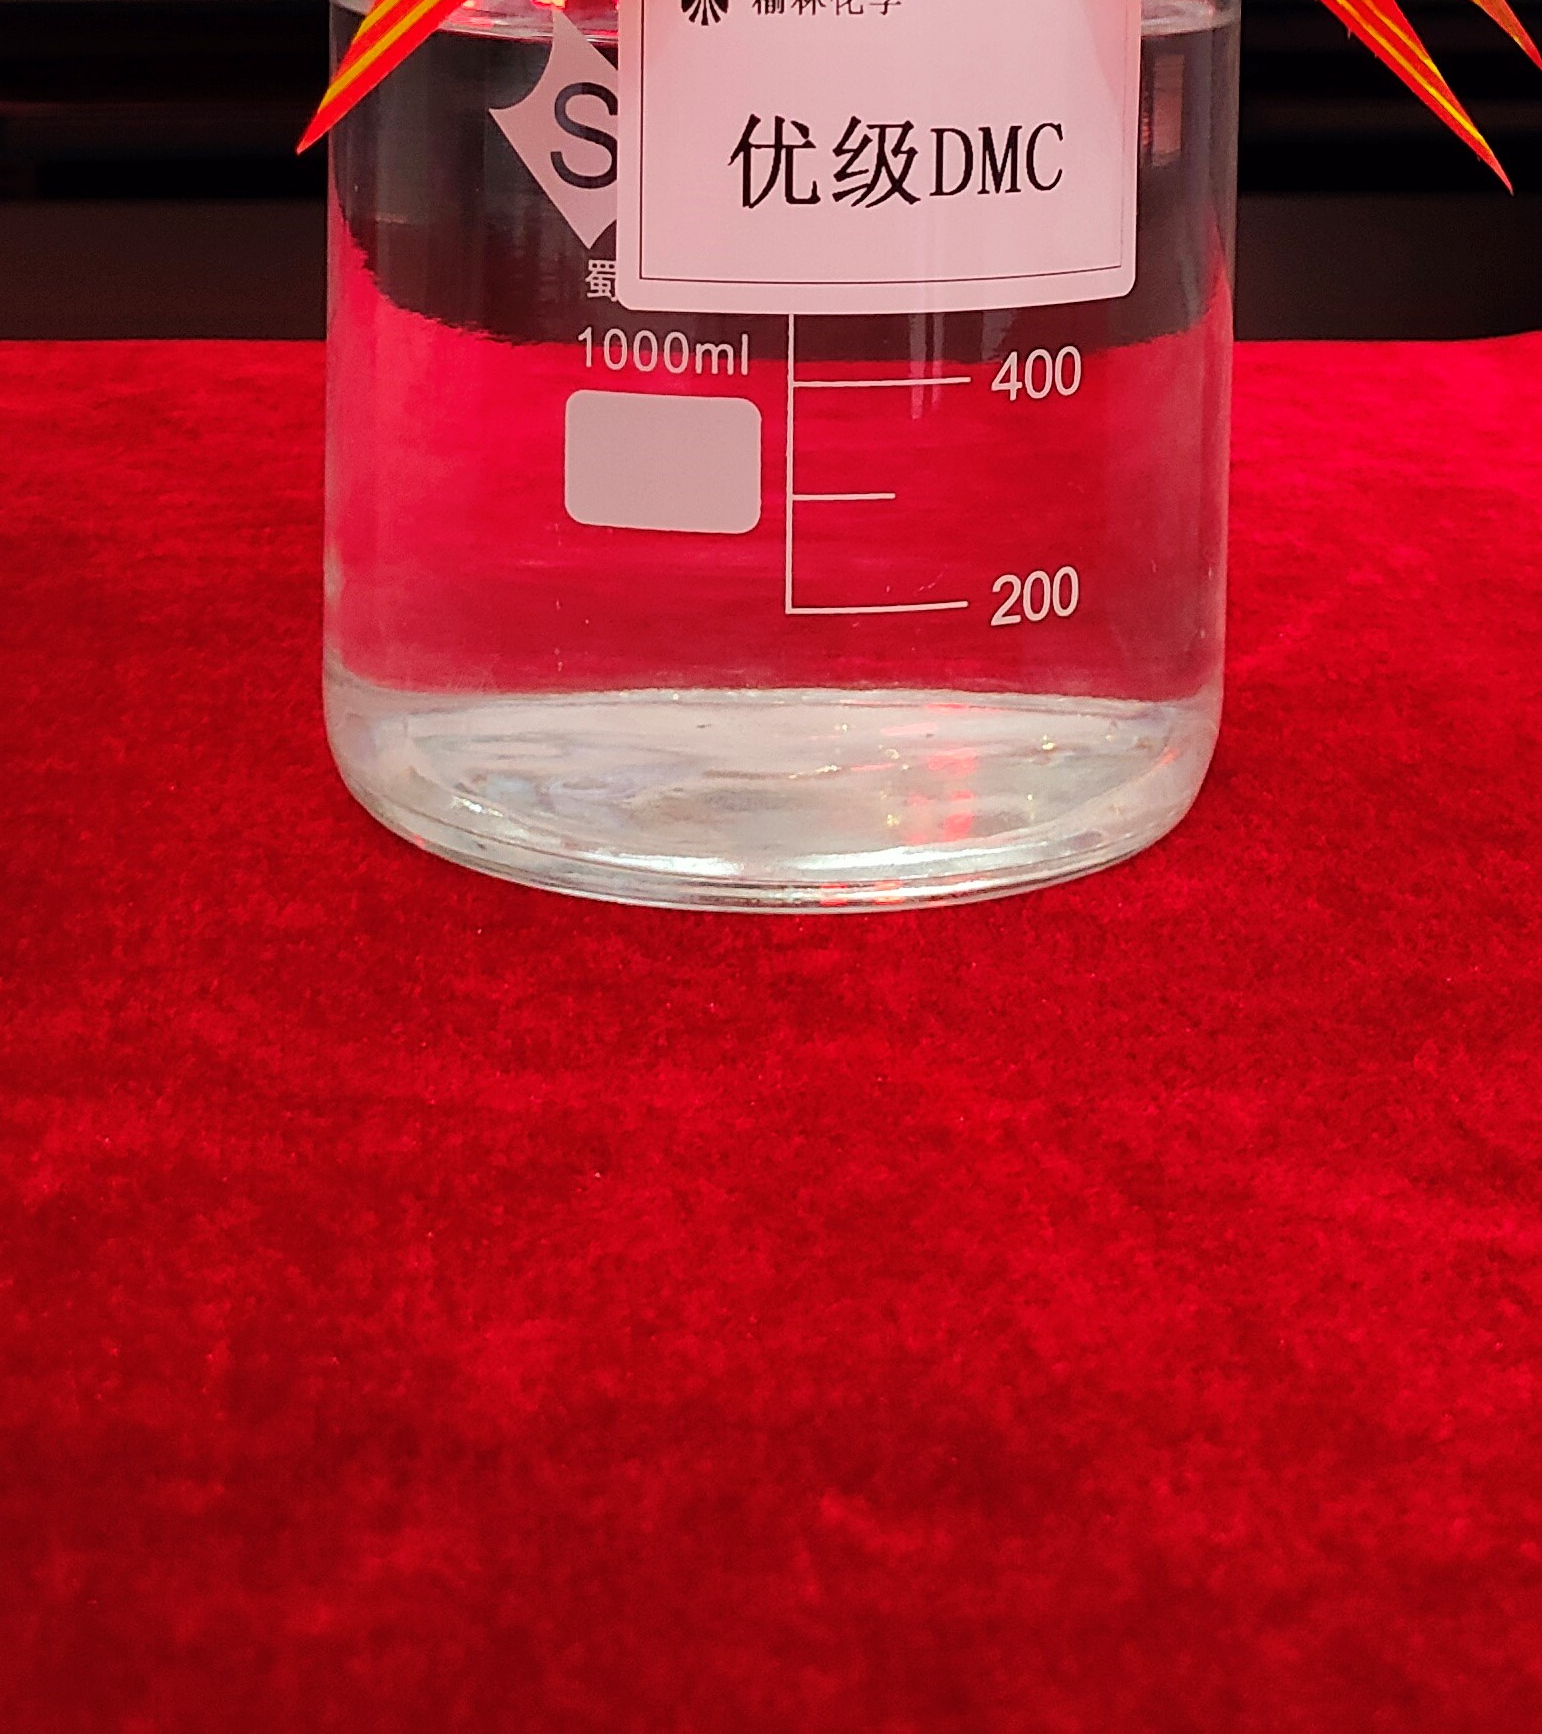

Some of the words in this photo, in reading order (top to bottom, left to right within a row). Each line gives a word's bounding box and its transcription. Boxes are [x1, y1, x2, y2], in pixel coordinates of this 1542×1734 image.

[550, 81, 618, 189] S
[727, 113, 1065, 210] 优级DMC
[576, 326, 750, 377] 1000ml
[990, 344, 1083, 402] 400
[989, 565, 1081, 627] 200
